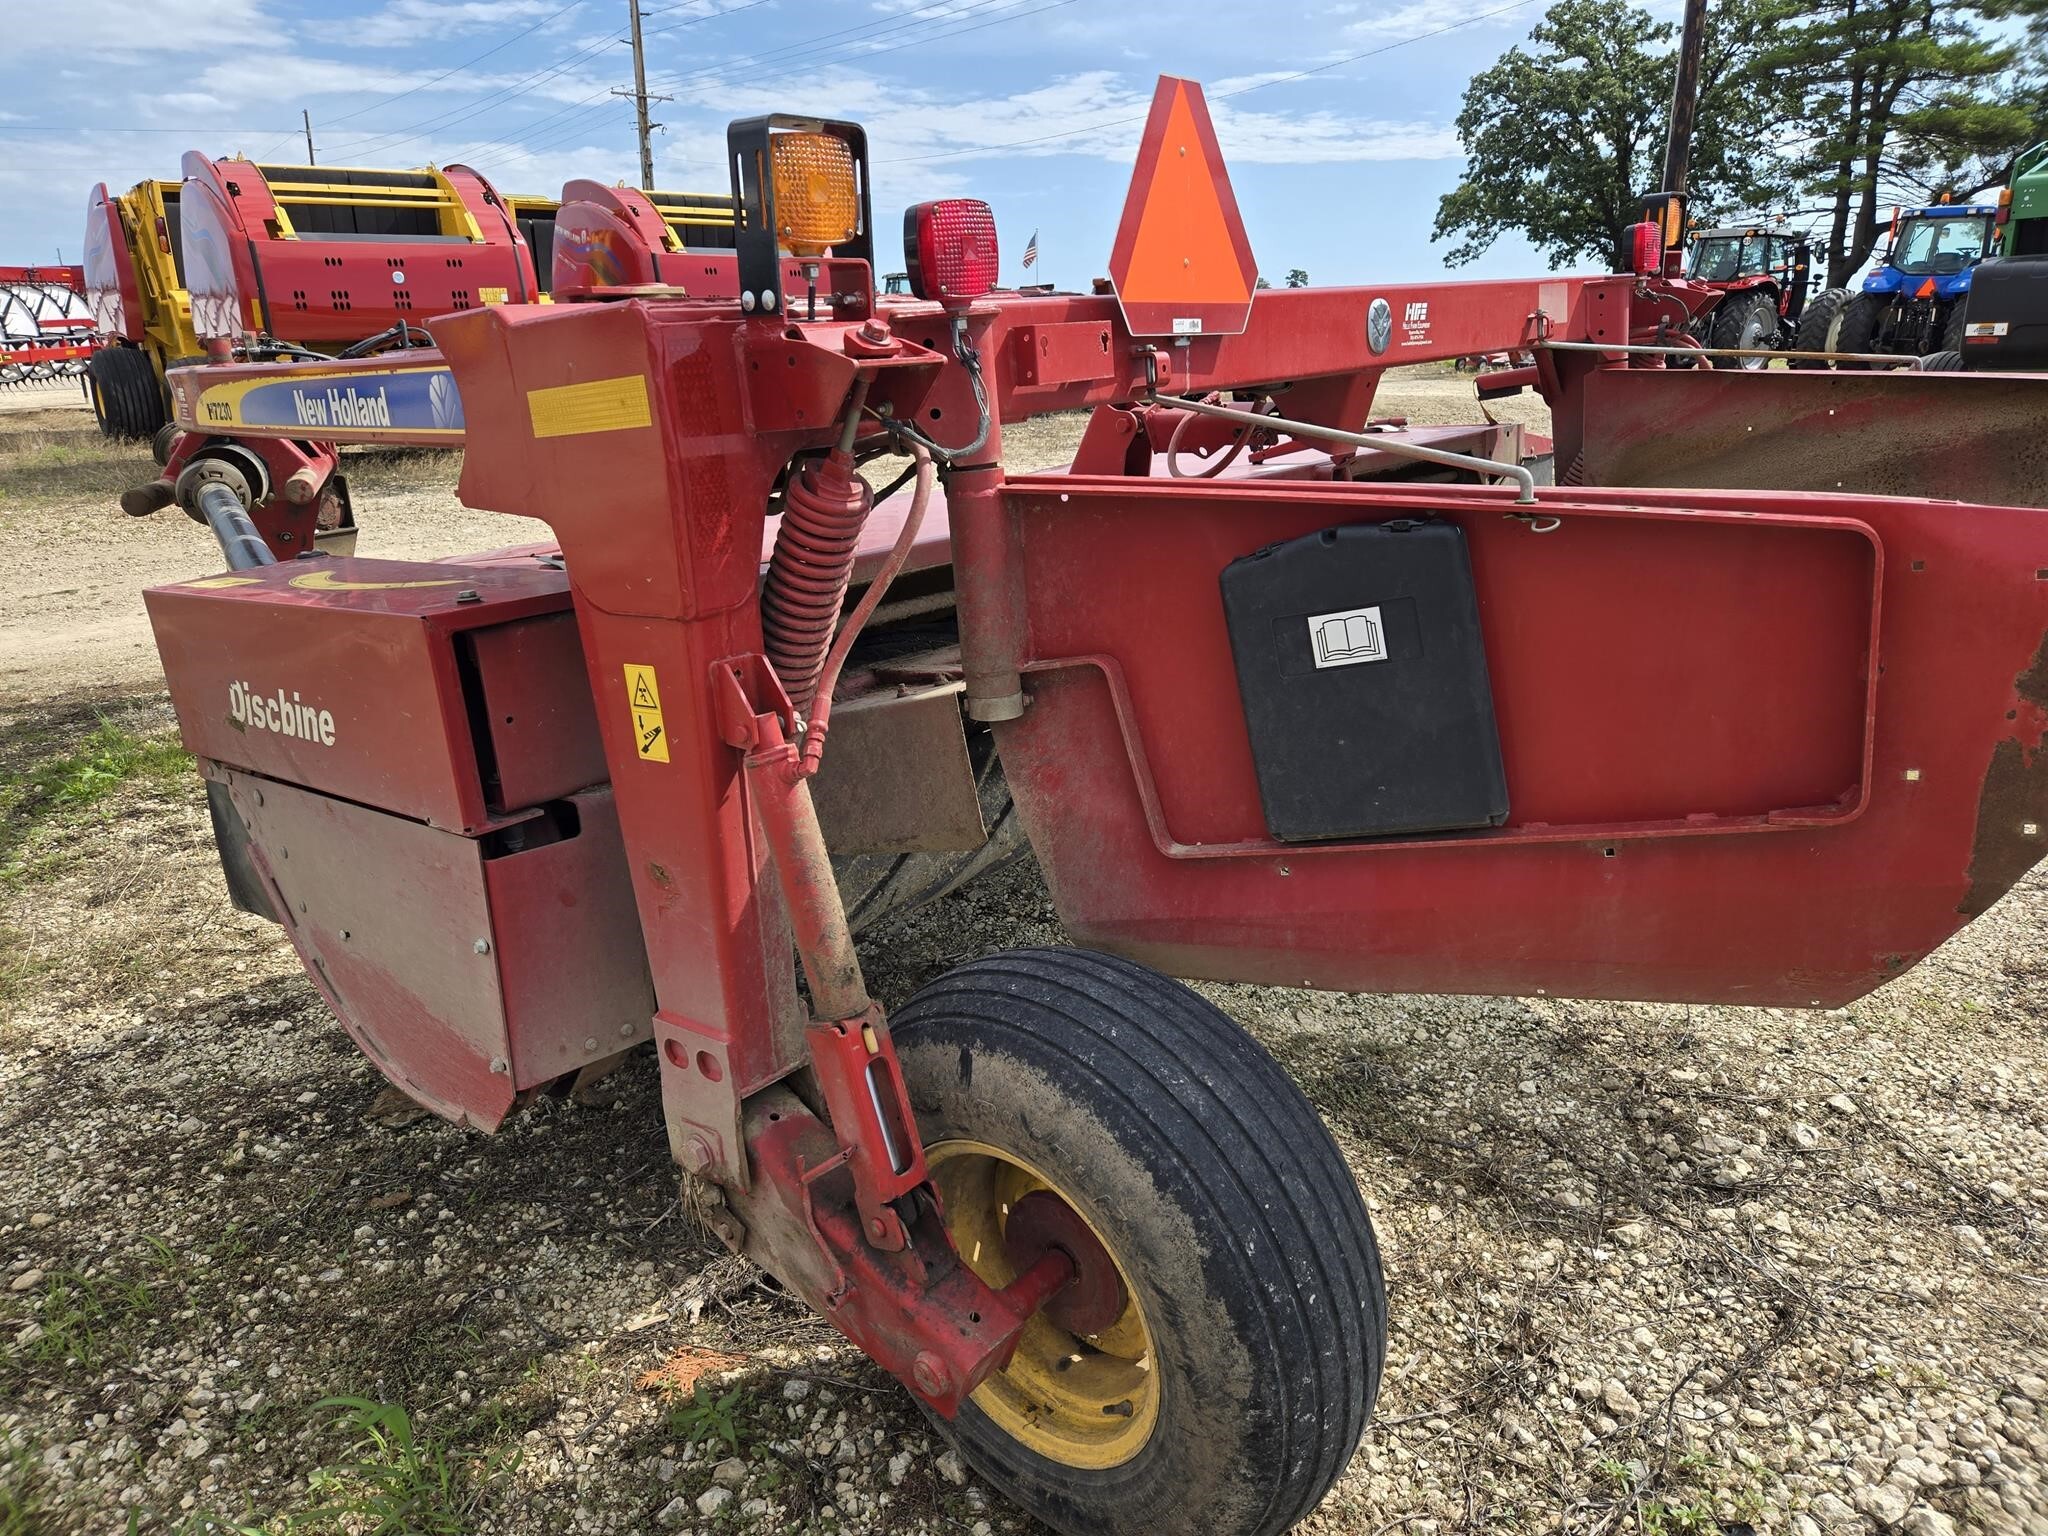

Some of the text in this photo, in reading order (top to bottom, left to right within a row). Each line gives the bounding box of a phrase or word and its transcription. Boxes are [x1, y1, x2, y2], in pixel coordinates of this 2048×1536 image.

[293, 386, 391, 427] New Holland
[229, 680, 336, 747] Discbine
